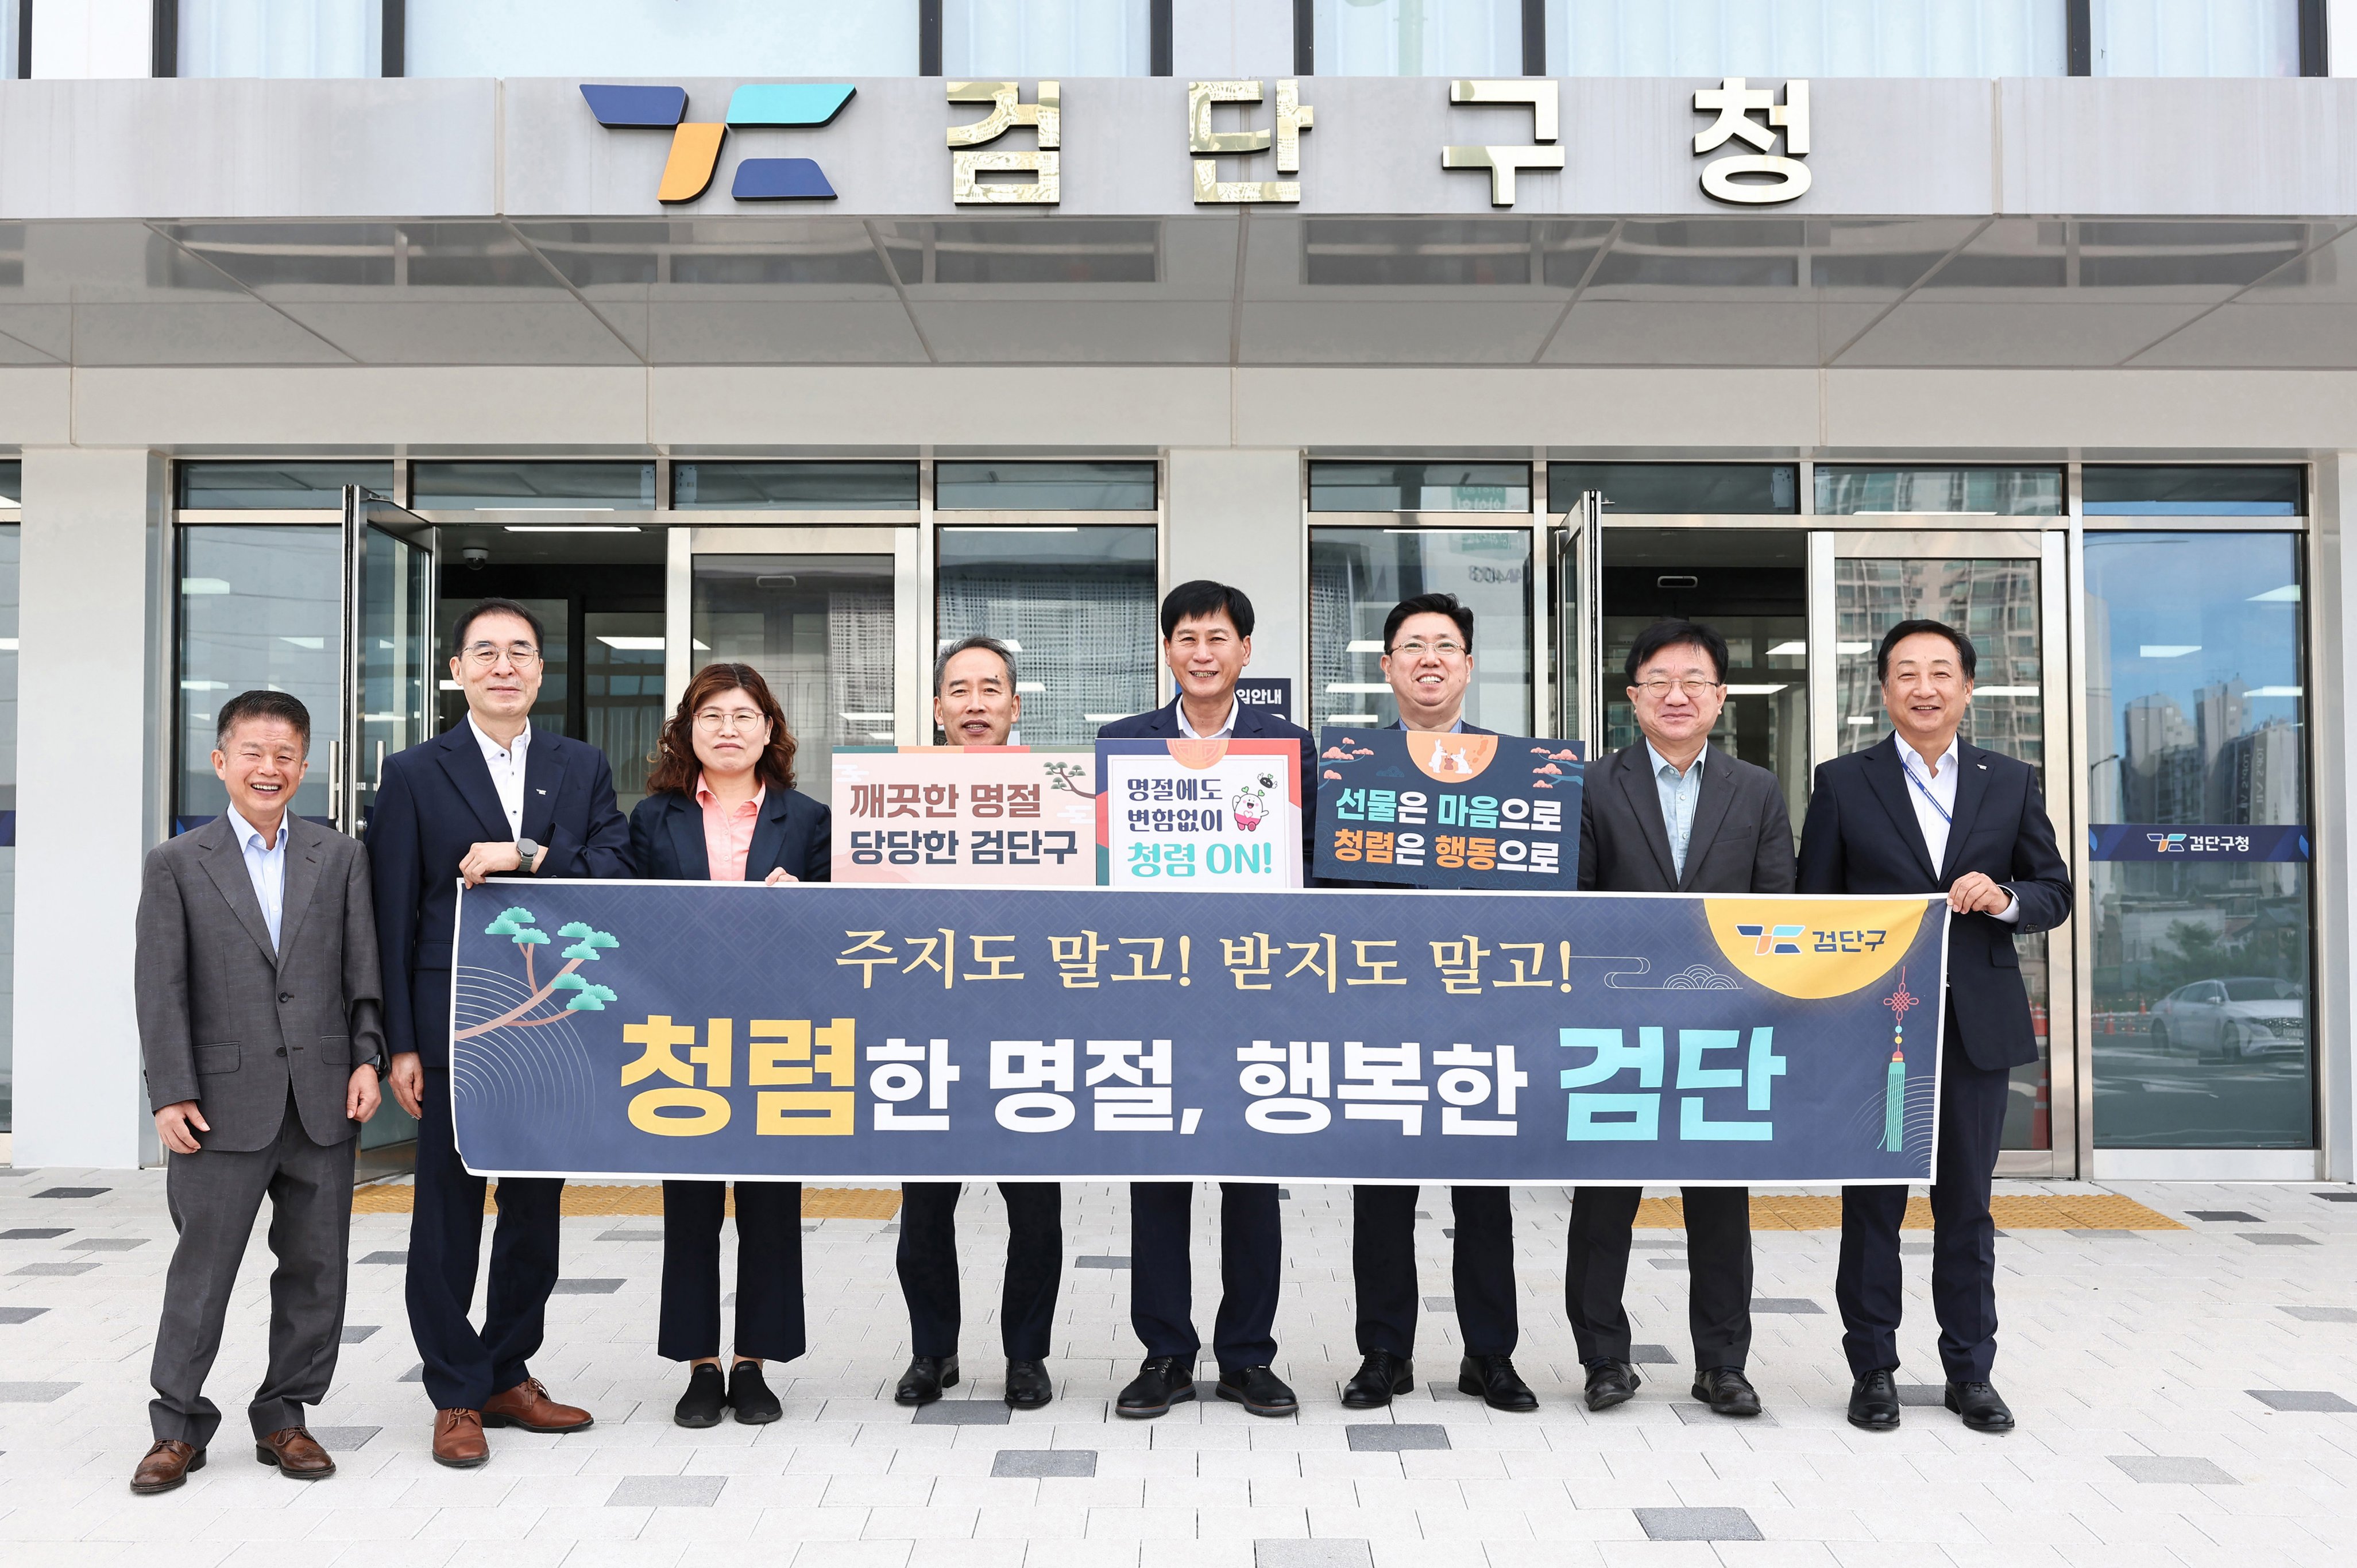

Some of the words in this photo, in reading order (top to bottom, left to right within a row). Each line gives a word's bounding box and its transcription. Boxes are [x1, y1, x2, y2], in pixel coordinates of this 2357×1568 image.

[946, 78, 1812, 206] 검단구청
[850, 784, 959, 818] 깨끗한
[971, 784, 1041, 818] 명절
[1127, 779, 1223, 801] 명절에도
[1128, 808, 1222, 832] 변함없이
[1336, 788, 1428, 824] 선물은
[1438, 794, 1562, 832] 마음으로
[851, 830, 959, 865] 당당한
[971, 830, 1077, 865] 검단구
[1127, 842, 1195, 877] 청렴
[1206, 842, 1272, 874] ON!
[1334, 828, 1425, 866] 청렴은
[1435, 835, 1559, 874] 행동으로
[2189, 835, 2250, 852] 검단구청
[1812, 930, 1887, 953] 검단구
[836, 928, 1025, 989] 주지도
[1047, 929, 1191, 988] 말고!
[1219, 931, 1407, 993] 받지도
[1428, 934, 1572, 994] 말고!
[620, 1015, 960, 1136] 청렴한
[989, 1038, 1203, 1135] 명절,
[1236, 1040, 1527, 1136] 행복한
[1559, 1026, 1787, 1140] 검단
